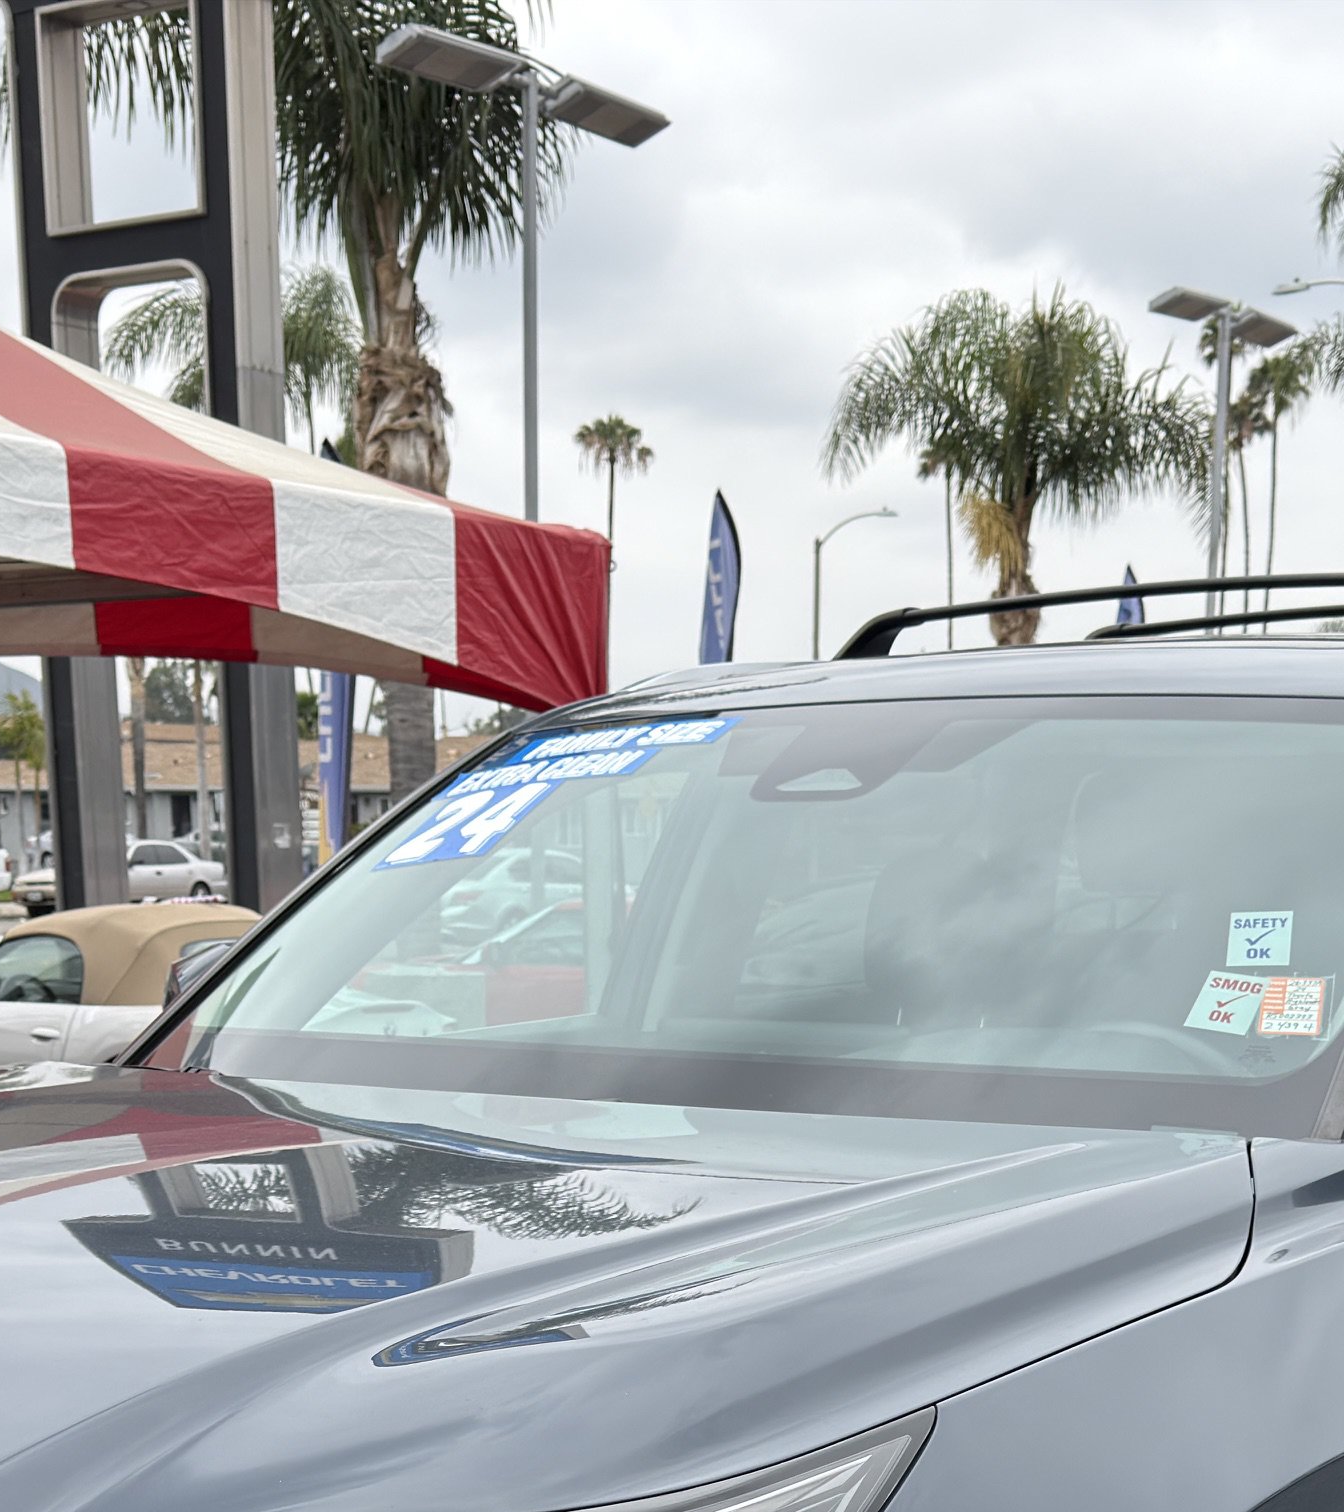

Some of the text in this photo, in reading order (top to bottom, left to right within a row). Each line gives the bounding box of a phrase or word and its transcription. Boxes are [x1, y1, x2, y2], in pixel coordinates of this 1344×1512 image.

[522, 720, 728, 762] FAMILY SIZE
[446, 749, 646, 797] EXTRA CLEAN
[385, 782, 552, 865] 24
[1233, 917, 1289, 930] SAFETY
[1246, 948, 1272, 959] OK
[1209, 977, 1264, 995] SMOG
[1208, 1010, 1235, 1024] OK
